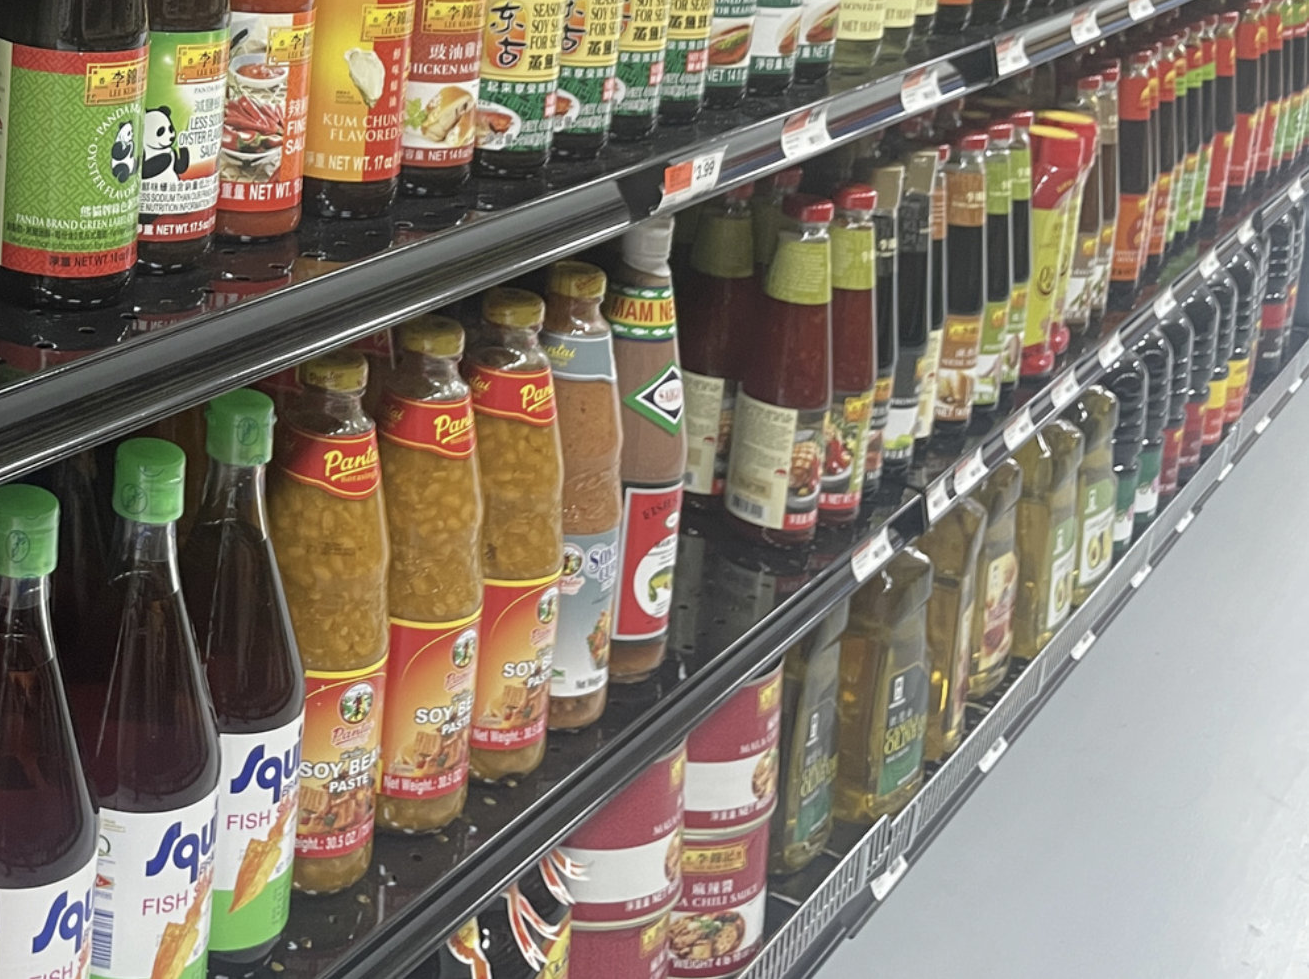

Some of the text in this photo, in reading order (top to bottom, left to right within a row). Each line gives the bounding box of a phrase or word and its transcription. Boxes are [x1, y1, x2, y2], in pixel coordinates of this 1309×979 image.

[591, 6, 610, 20] SOY
[634, 7, 652, 22] FOR
[491, 0, 529, 67] 东古
[531, 19, 551, 34] SOY
[591, 22, 608, 36] FOR
[529, 35, 548, 50] FOR
[705, 69, 726, 81] NET
[190, 117, 208, 130] LESS
[323, 112, 359, 128] KUM
[330, 127, 397, 143] FLAVORED
[374, 156, 383, 169] 17
[428, 150, 447, 161] NET
[151, 193, 176, 203] SODIUM
[145, 203, 179, 212] NUTRITION
[16, 213, 108, 230] PANDA BRAND GREEN
[156, 223, 173, 234] NET
[74, 255, 93, 267] NET
[415, 707, 454, 725] SOY
[299, 761, 343, 779] SOY
[328, 772, 370, 794] PASTE
[226, 809, 271, 830] FISH
[143, 889, 189, 916] FISH
[692, 884, 758, 908] CHILI SAUCE
[672, 957, 714, 970] WEIGHT
